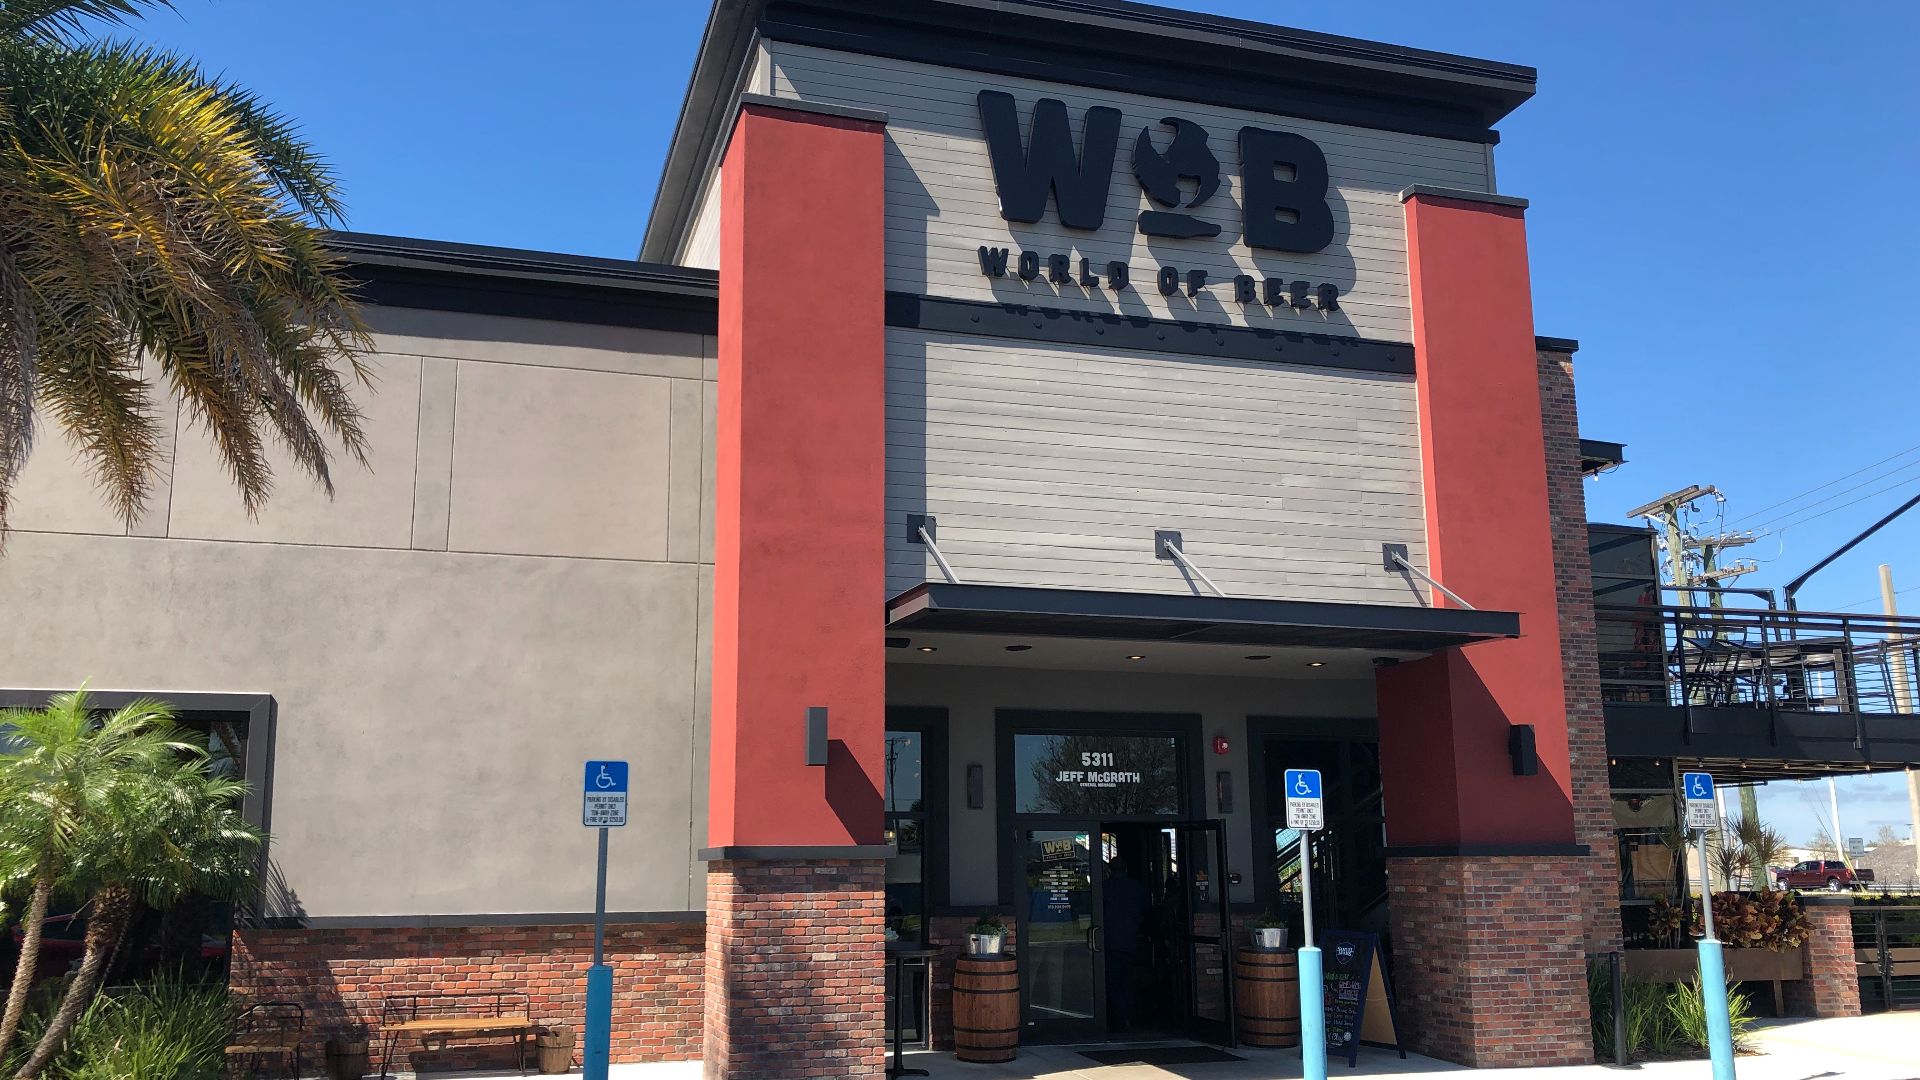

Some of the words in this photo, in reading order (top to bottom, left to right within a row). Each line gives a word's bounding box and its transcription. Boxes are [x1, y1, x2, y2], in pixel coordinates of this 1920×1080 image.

[977, 245, 1130, 292] WORLD
[1157, 265, 1208, 298] OF
[1233, 274, 1341, 312] BEER
[1081, 752, 1114, 767] 5311
[1055, 771, 1084, 782] JEFF
